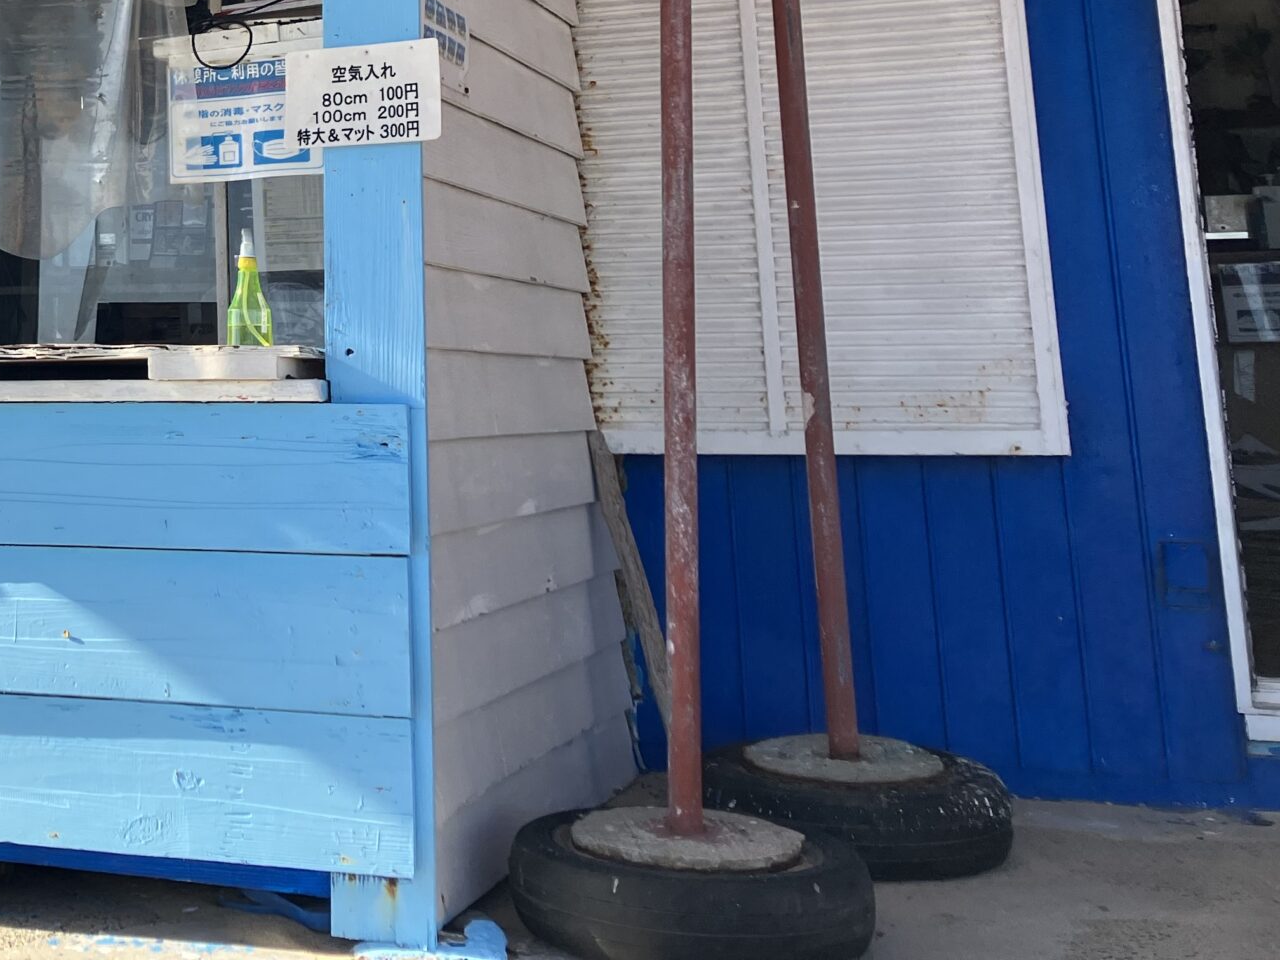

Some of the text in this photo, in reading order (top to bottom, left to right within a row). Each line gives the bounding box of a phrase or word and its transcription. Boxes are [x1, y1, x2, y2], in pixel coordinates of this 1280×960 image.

[331, 62, 397, 83] 空気入れ
[322, 83, 419, 107] 80cm 100円
[312, 102, 419, 124] 100cm 200円
[380, 121, 419, 139] 300円
